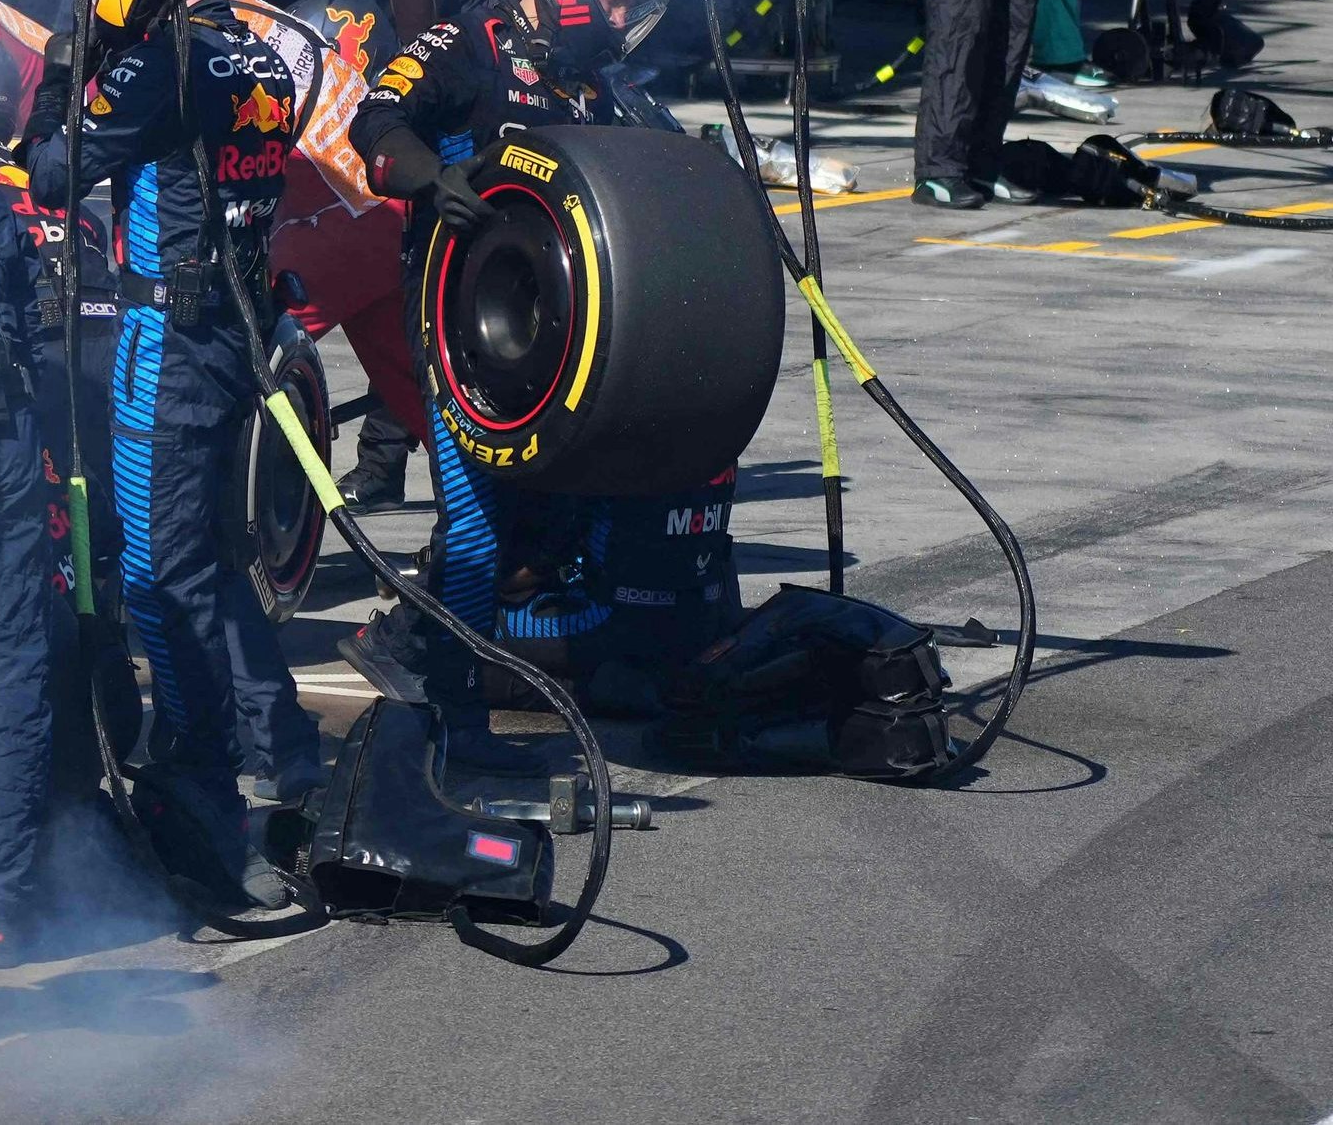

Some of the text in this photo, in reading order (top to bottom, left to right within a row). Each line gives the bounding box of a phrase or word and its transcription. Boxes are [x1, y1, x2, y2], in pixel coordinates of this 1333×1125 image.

[413, 44, 432, 62] Sui
[369, 89, 401, 104] VISA
[508, 89, 539, 107] Mobil
[500, 144, 559, 183] PIRELLI
[441, 408, 514, 467] ZERO
[522, 432, 539, 462] P
[666, 503, 723, 536] Mobil
